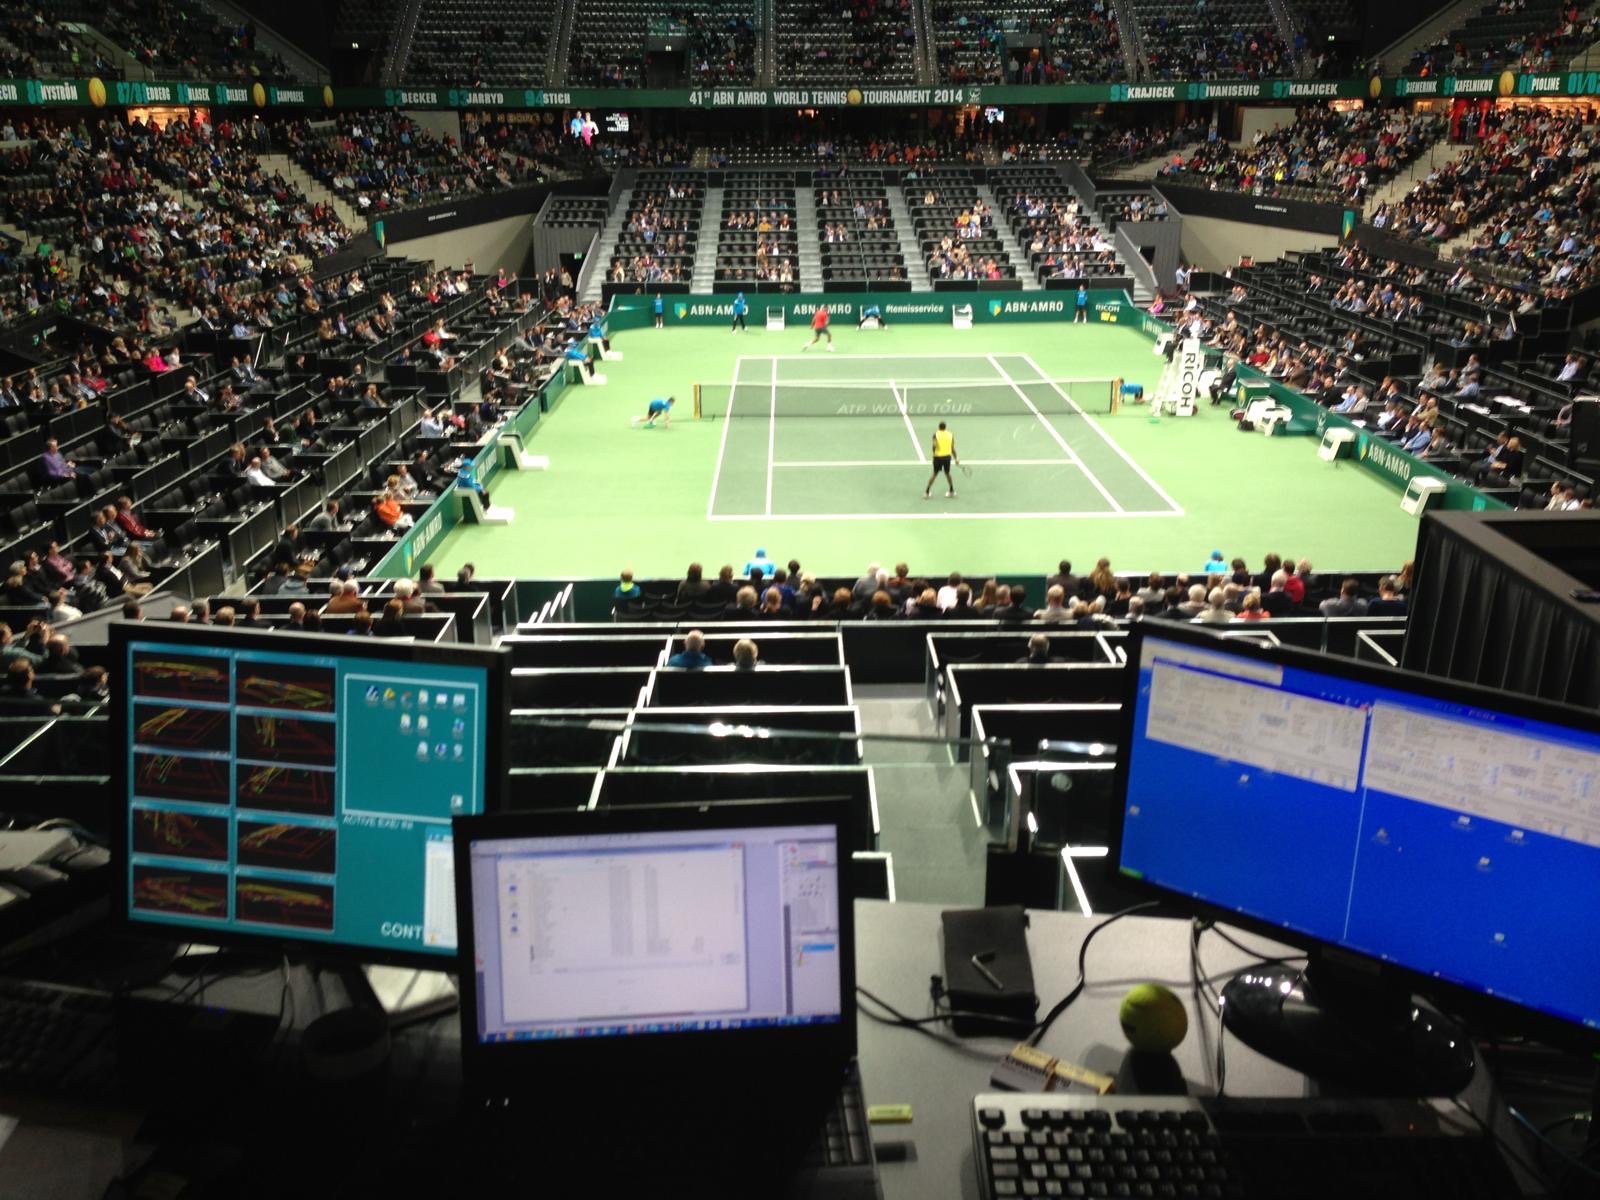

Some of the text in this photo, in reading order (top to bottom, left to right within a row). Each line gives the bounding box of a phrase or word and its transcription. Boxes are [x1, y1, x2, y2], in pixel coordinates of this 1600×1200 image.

[1289, 83, 1337, 96] KRAJICEK
[1455, 79, 1493, 92] KAFELNIKOV
[1531, 77, 1560, 91] PIOLINE
[40, 82, 78, 101] NYSTRÖM
[146, 87, 171, 101] EDBERG
[713, 91, 734, 105] ABN
[737, 91, 767, 105] AMRO
[773, 91, 808, 105] WORLD
[812, 91, 847, 105] TENNIS
[863, 90, 931, 104] TOURNAMENT
[934, 90, 963, 103] 2014
[1127, 86, 1175, 99] KRAJICEK
[1205, 85, 1260, 97] IVANISEVIC
[401, 92, 437, 104] BECKER
[466, 92, 504, 104] JARRYD
[543, 93, 571, 104] STICH
[1180, 353, 1196, 408] RICOH
[836, 404, 866, 414] ATP
[931, 403, 972, 414] TOUR
